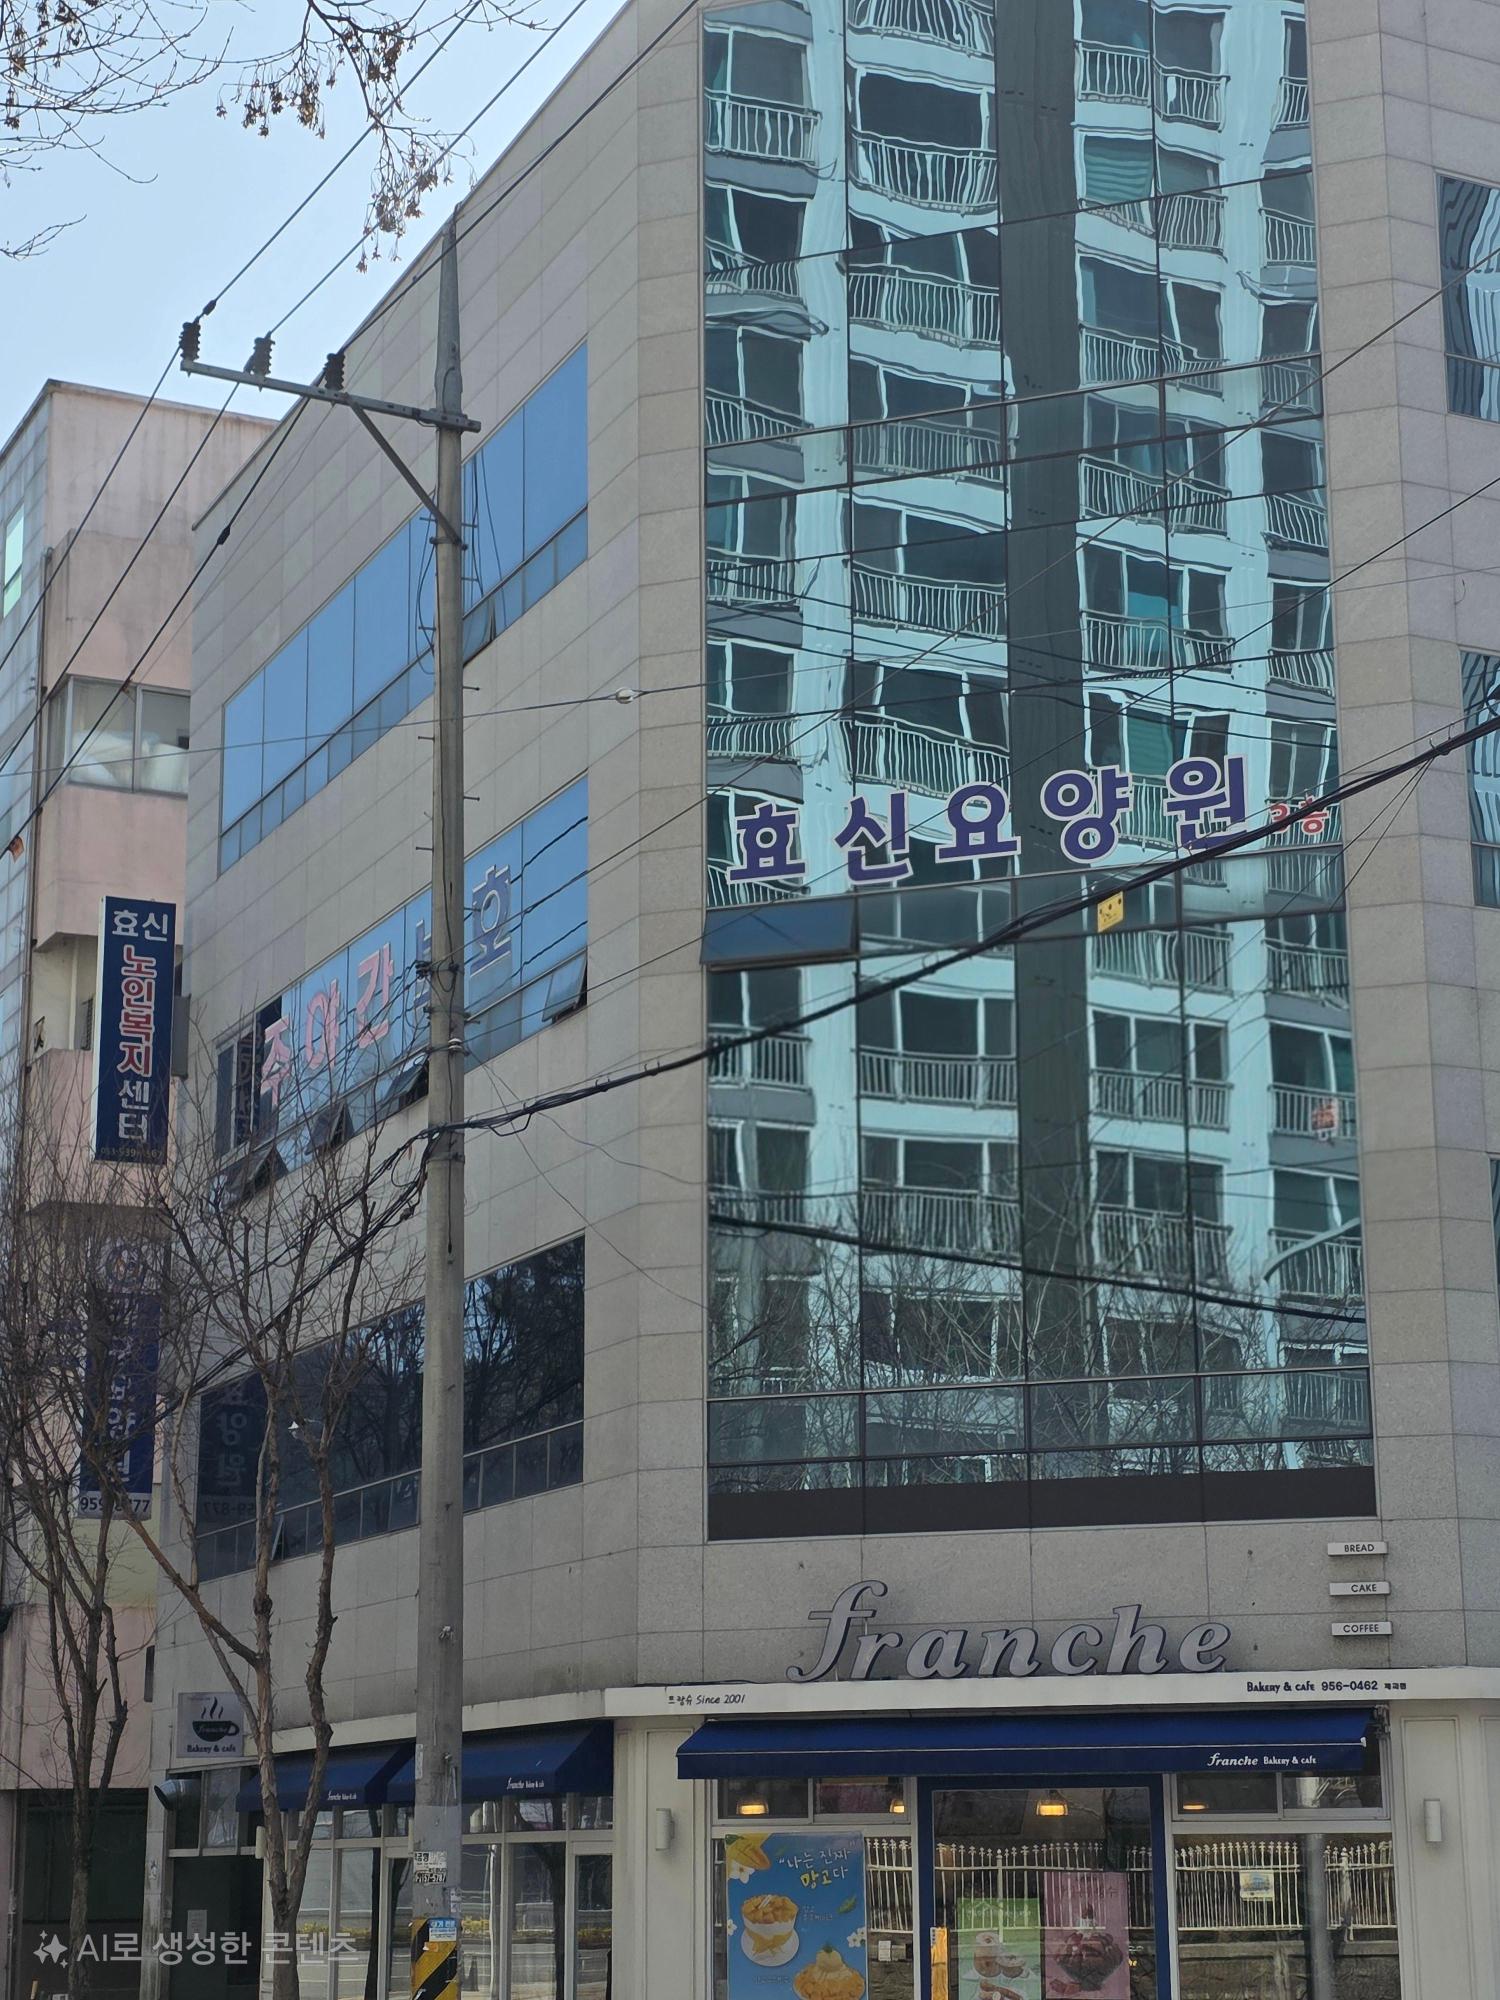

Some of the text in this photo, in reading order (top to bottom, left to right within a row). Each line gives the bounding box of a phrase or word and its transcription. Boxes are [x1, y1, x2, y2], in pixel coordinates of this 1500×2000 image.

[112, 909, 168, 942] 효신
[1344, 1544, 1375, 1553] BREAD
[1350, 1584, 1377, 1593] CAKE
[785, 1579, 1232, 1683] franche
[1342, 1623, 1380, 1633] COFFEE
[1283, 1682, 1292, 1692] &
[1321, 1680, 1378, 1691] 956-0462
[695, 1695, 720, 1705] Since
[723, 1694, 746, 1704] 2001
[213, 1744, 220, 1753] &
[1207, 1752, 1258, 1766] franche
[1291, 1756, 1299, 1765] &
[800, 1865, 849, 1889] 망고다
